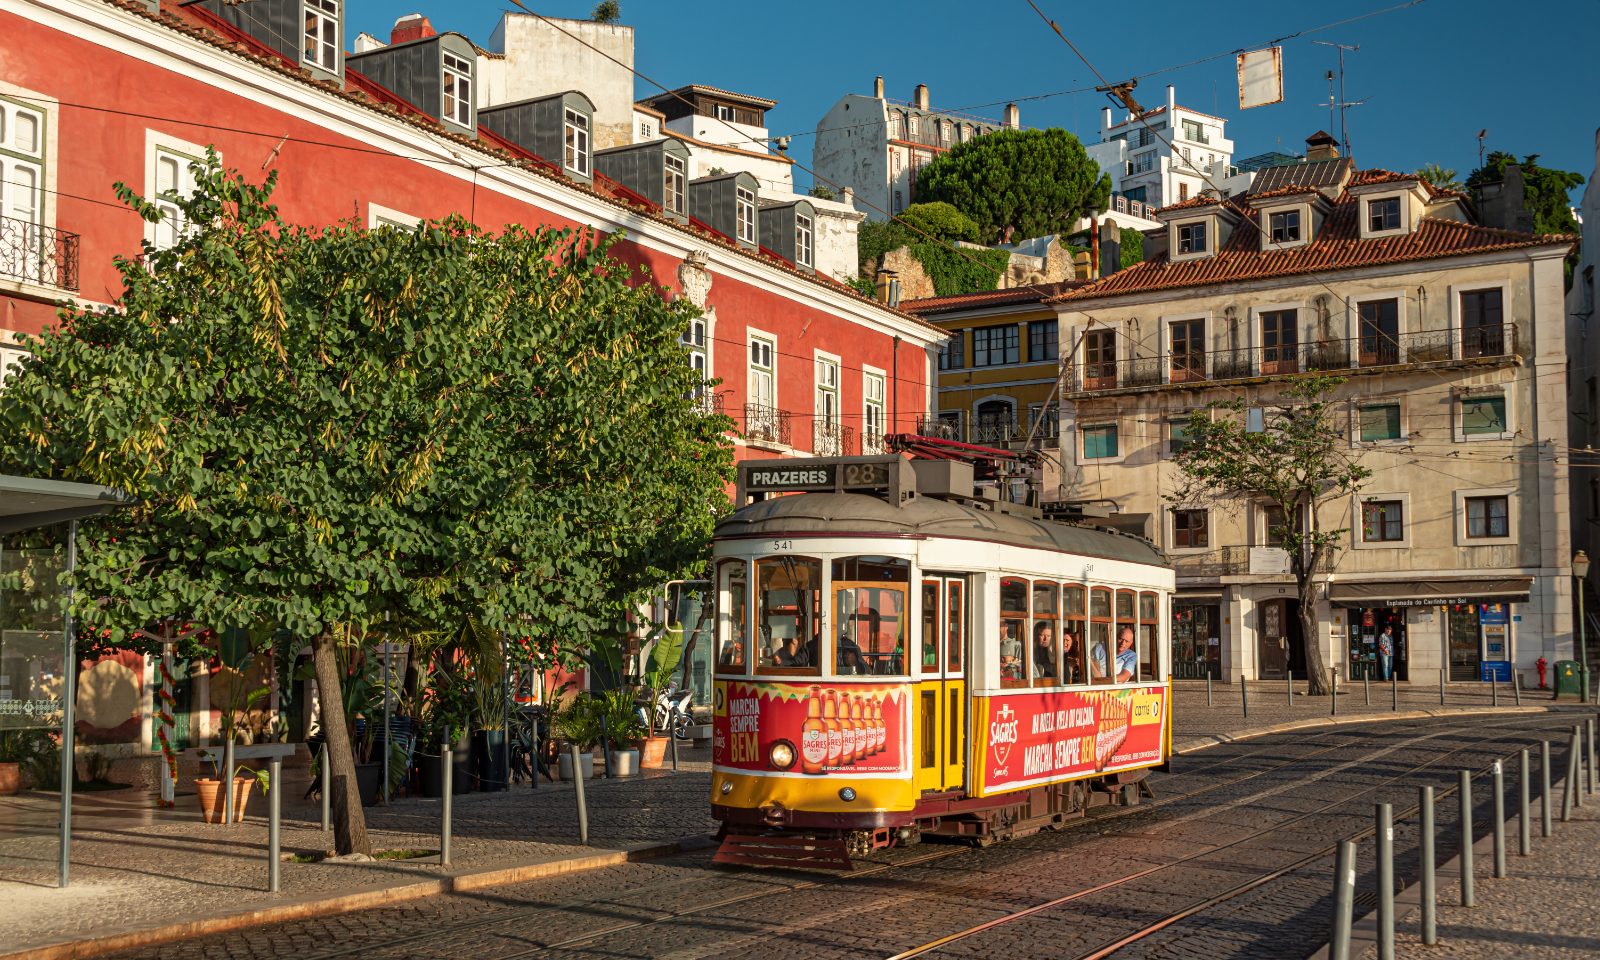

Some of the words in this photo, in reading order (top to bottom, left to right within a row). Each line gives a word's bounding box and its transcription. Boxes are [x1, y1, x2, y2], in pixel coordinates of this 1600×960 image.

[752, 470, 827, 485] PRAZERES
[846, 464, 875, 484] 28
[773, 540, 793, 550] 541
[1086, 563, 1094, 572] 541
[729, 697, 760, 716] MARCHA
[730, 714, 760, 733] SEMPRE
[990, 719, 1018, 747] SAGRES
[730, 732, 760, 763] BEM
[803, 740, 827, 749] SAGRES
[1024, 742, 1053, 776] MARCHA
[1054, 737, 1081, 769] SEMPRE
[1081, 734, 1096, 764] BEM
